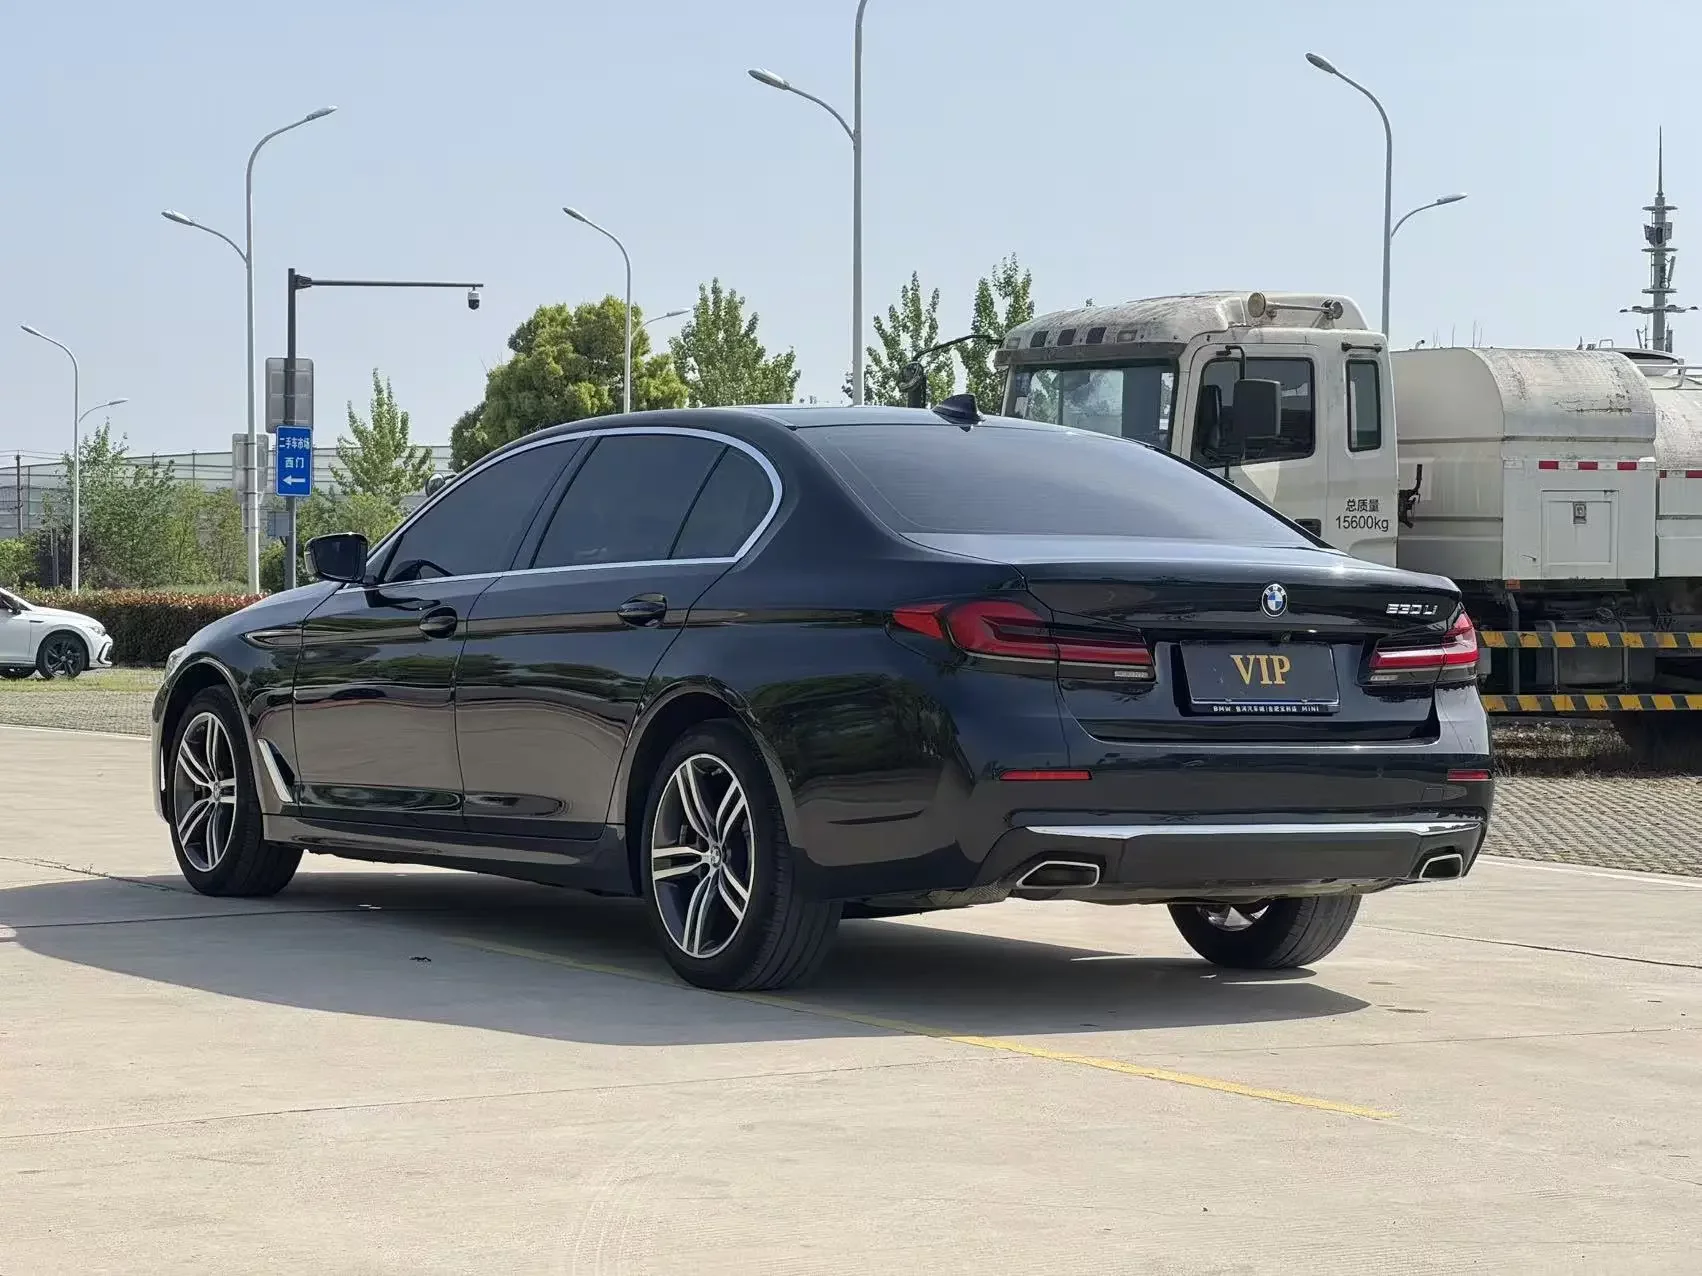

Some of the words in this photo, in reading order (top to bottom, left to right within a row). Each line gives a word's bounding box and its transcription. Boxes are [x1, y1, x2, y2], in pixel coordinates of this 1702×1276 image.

[279, 436, 310, 450] 二手车市场
[284, 456, 305, 469] 西门
[1345, 498, 1379, 512] 总质量
[1335, 515, 1389, 532] 15600kg
[1230, 654, 1291, 685] VIP
